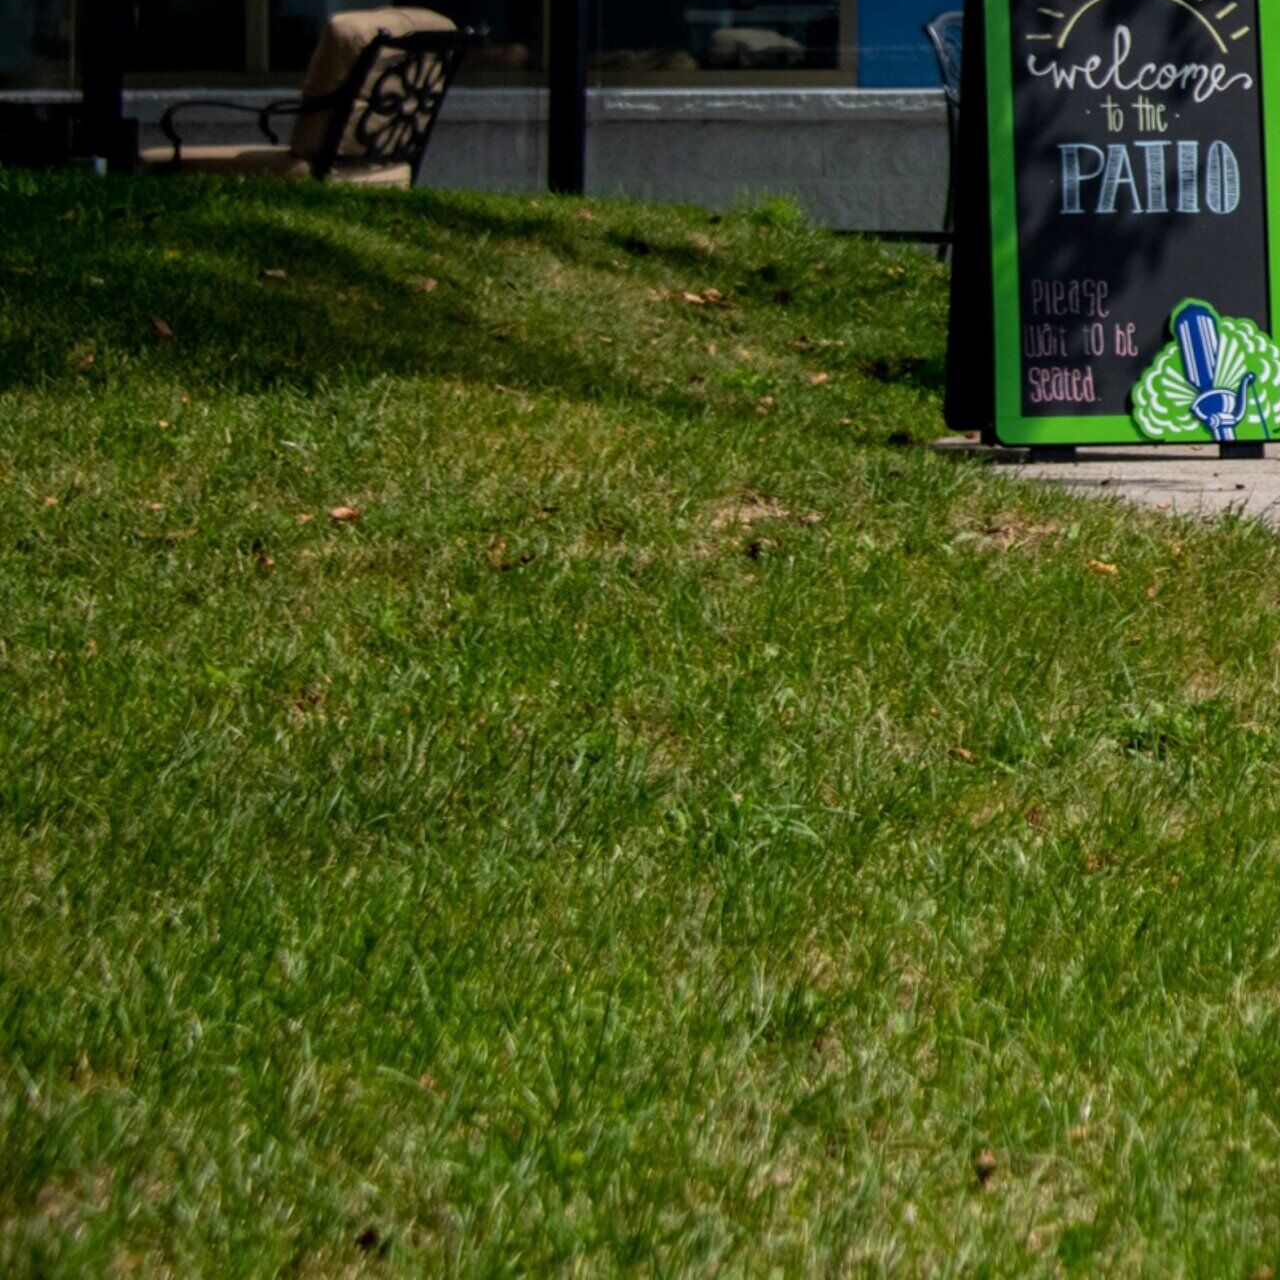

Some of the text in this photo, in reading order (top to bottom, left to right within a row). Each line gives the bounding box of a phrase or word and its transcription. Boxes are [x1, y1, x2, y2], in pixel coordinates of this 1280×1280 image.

[1027, 24, 1253, 103] welcome
[1101, 94, 1169, 132] to the
[1057, 139, 1241, 214] PATIO
[1115, 322, 1139, 357] be
